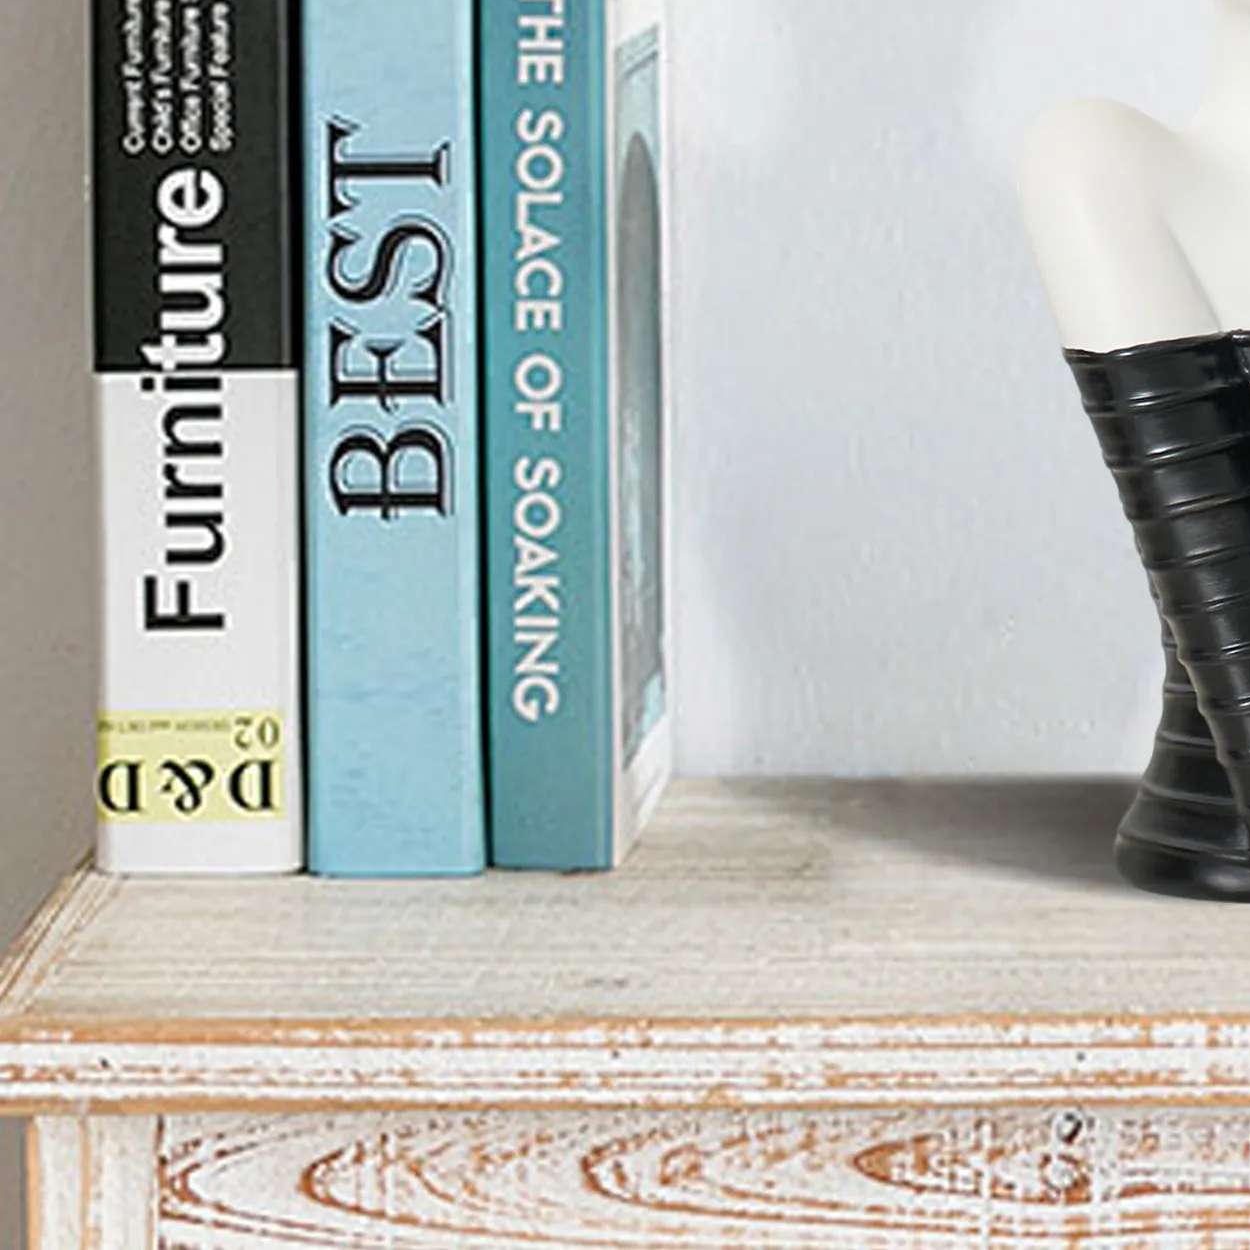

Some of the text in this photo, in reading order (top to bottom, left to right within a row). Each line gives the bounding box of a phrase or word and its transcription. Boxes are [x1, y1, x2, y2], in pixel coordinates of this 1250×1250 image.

[180, 6, 201, 91] Furniture
[328, 116, 452, 520] BEST
[515, 109, 563, 331] SOLACE
[142, 169, 224, 630] Furniture
[514, 353, 561, 432] OF
[512, 456, 560, 722] SOAKING
